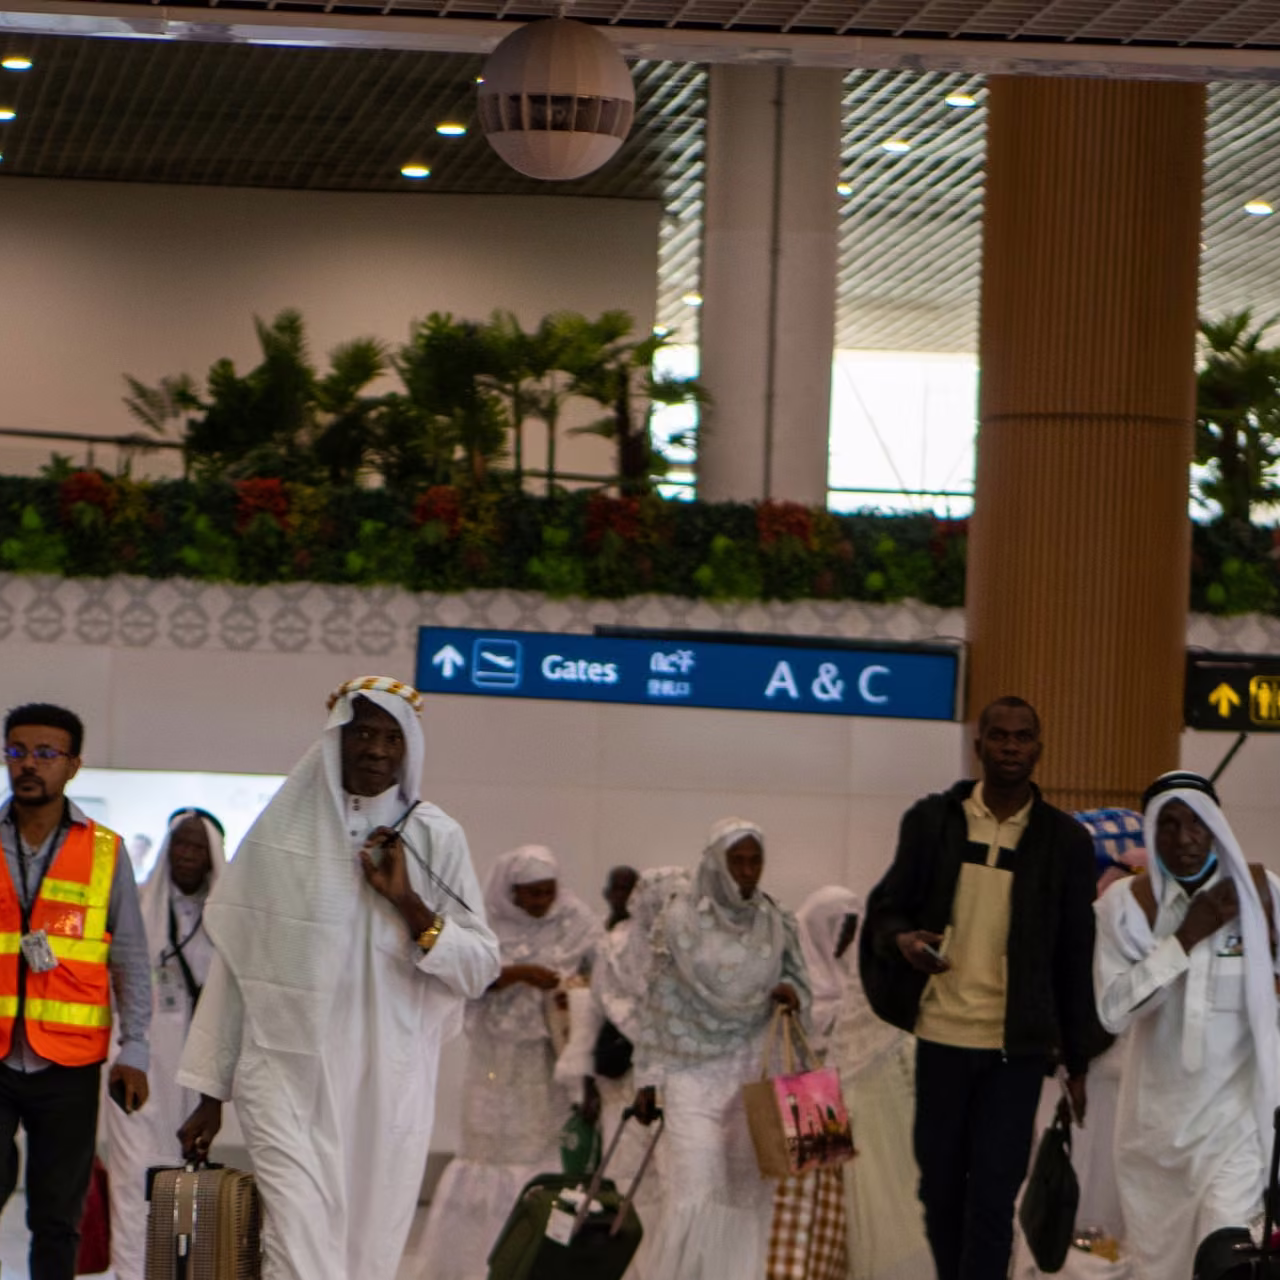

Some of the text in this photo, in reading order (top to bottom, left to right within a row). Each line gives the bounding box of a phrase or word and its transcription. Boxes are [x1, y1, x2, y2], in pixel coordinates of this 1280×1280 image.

[541, 653, 619, 684] Gates
[765, 660, 891, 704] A & C
